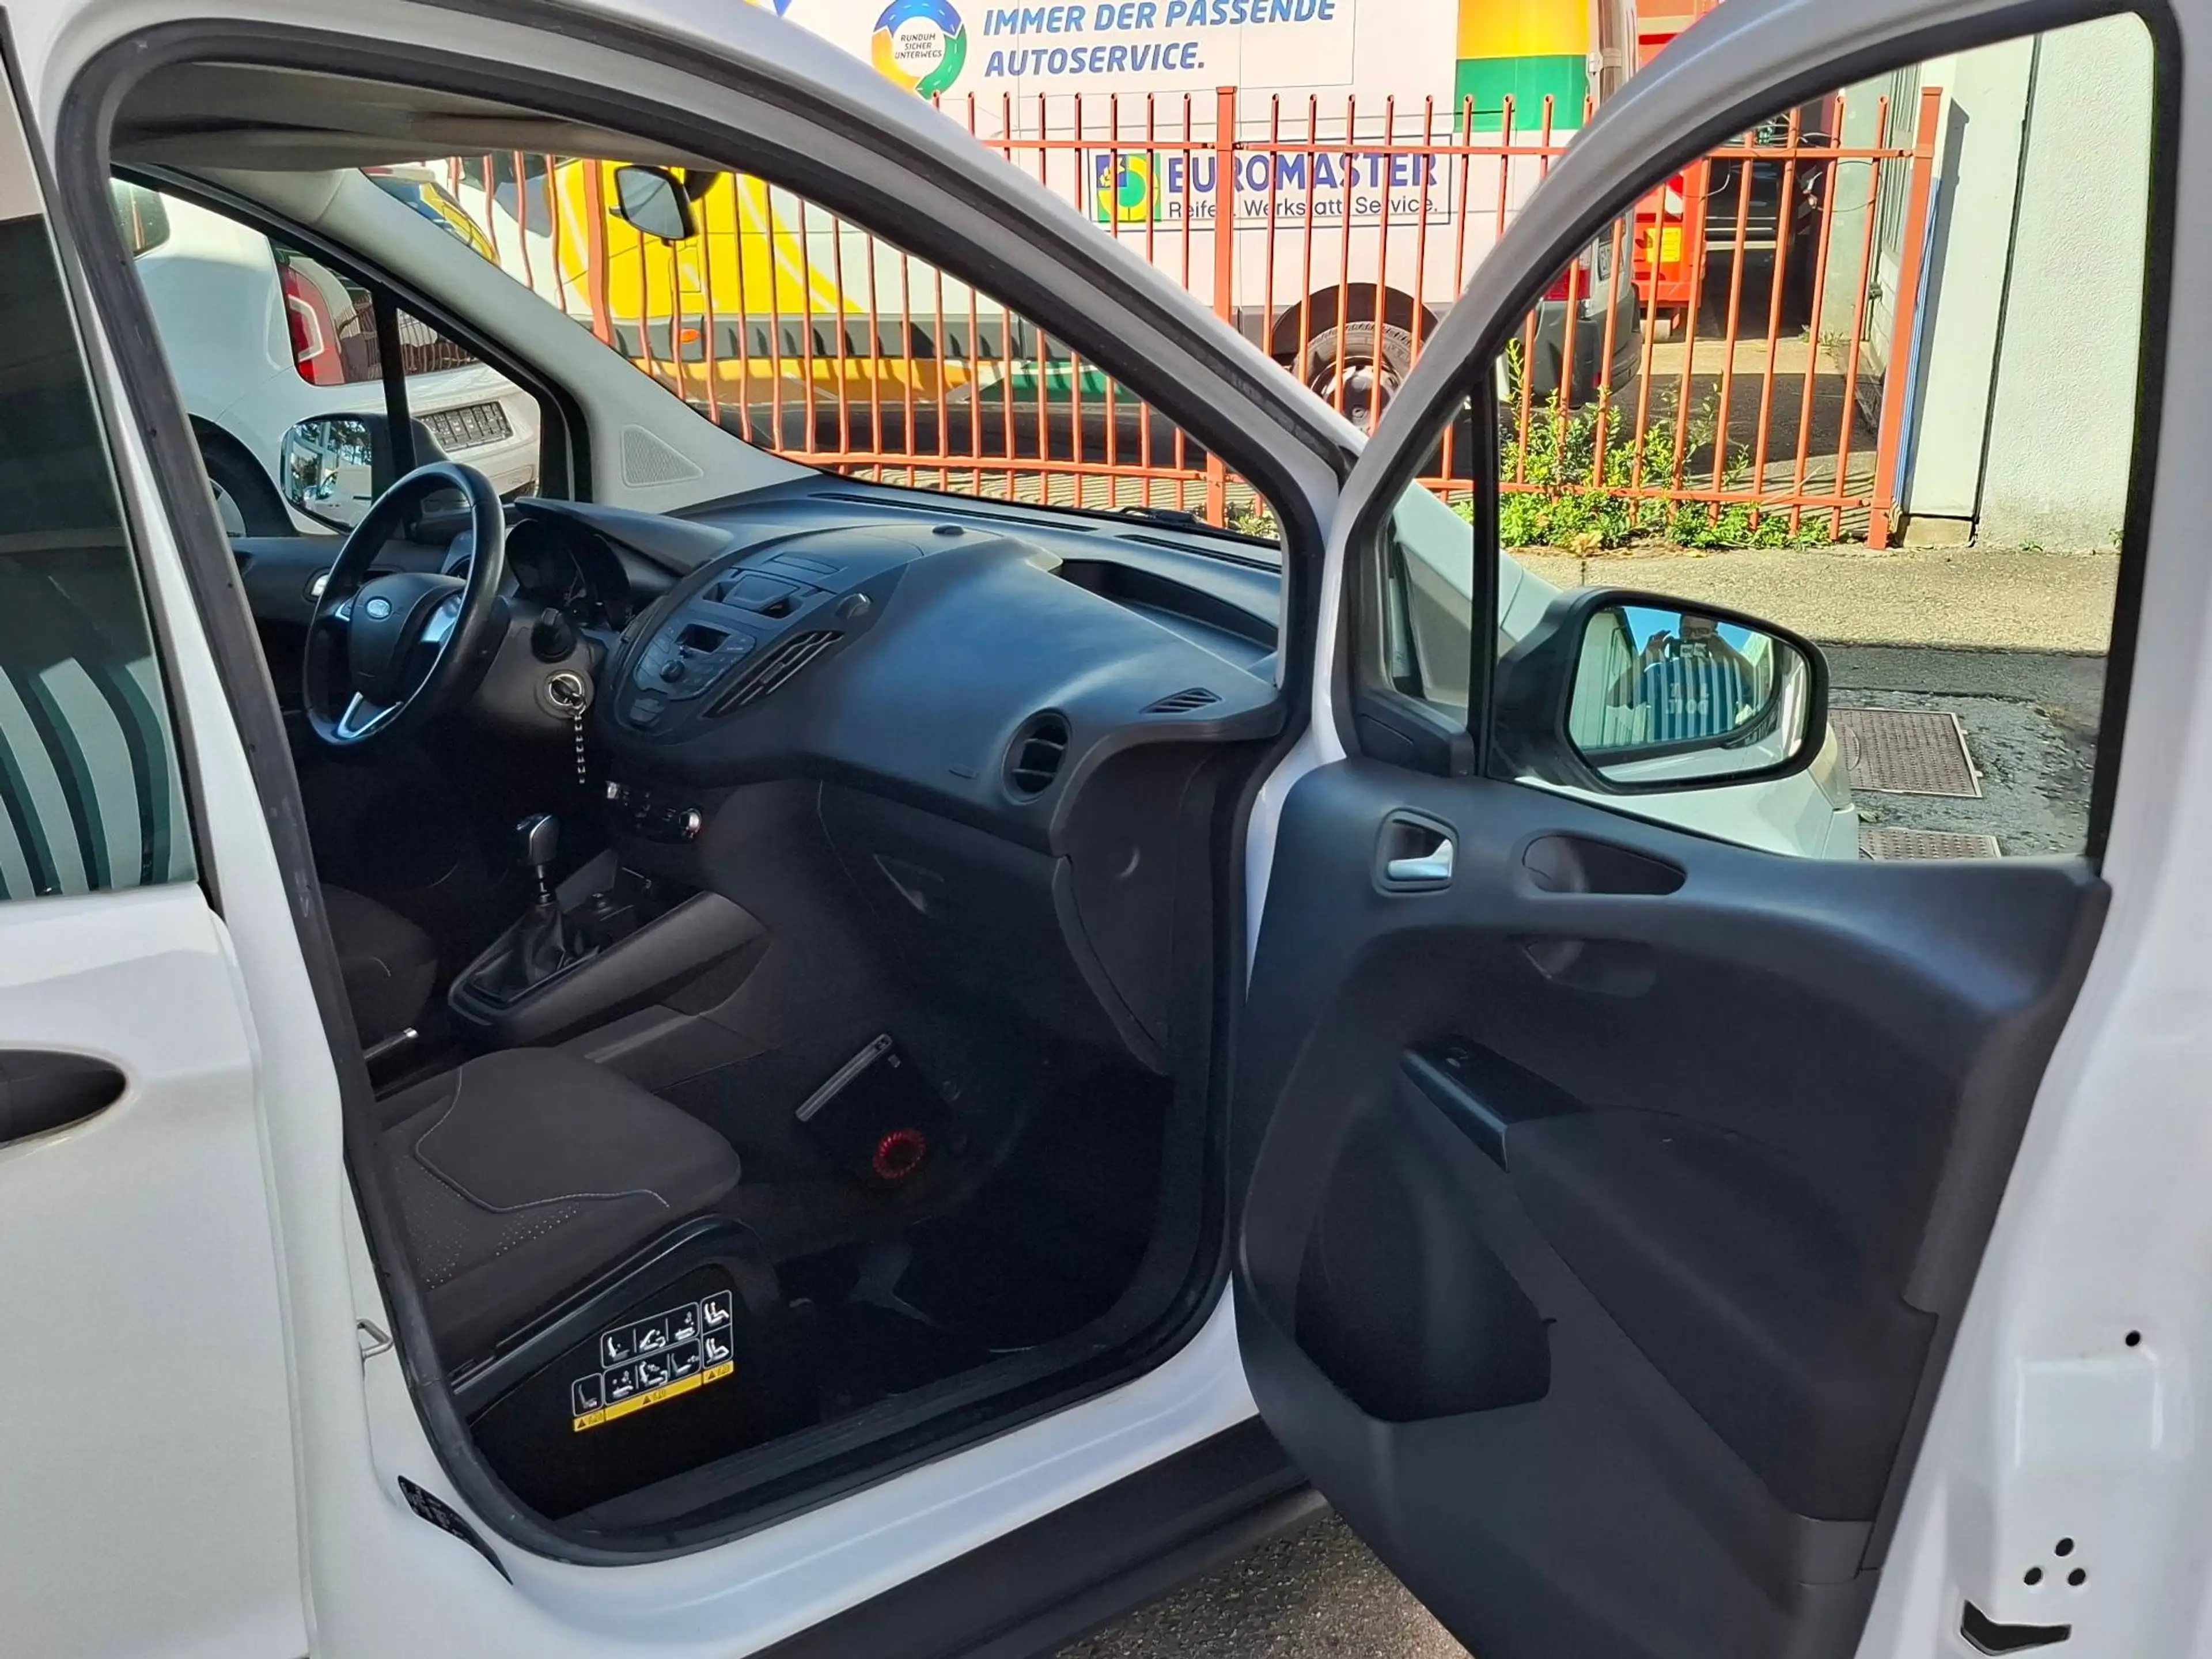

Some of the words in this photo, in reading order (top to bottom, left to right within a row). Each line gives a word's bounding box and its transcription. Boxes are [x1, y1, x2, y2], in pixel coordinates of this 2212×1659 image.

[983, 5, 1086, 36] IMMER
[1094, 2, 1157, 31] DER
[1165, 0, 1335, 27] PASSENDE
[900, 33, 936, 42] RUNDUM
[894, 50, 942, 59] UNTERWEGS
[904, 42, 932, 51] SICHER
[984, 41, 1205, 77] AUTOSERVICE.
[1169, 200, 1236, 218] Rife.
[1244, 198, 1342, 217] Wrksatt
[1355, 195, 1437, 214] Sevice.
